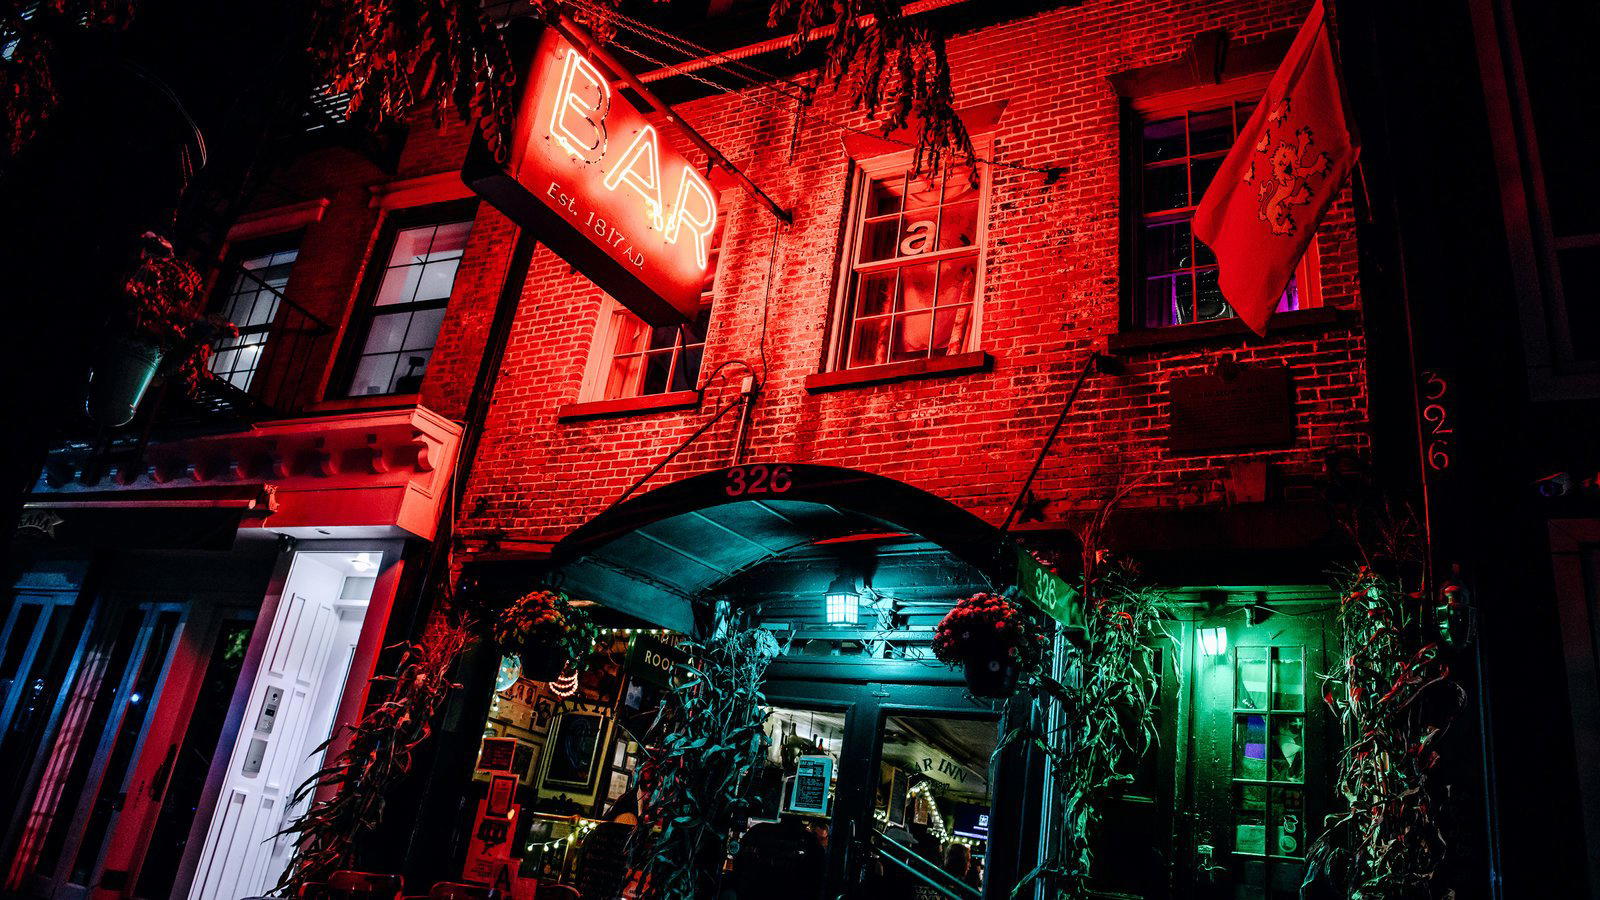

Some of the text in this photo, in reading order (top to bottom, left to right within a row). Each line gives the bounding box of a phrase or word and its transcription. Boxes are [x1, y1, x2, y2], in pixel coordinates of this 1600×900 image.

[545, 181, 579, 217] Est.
[584, 209, 625, 248] 1817
[900, 219, 937, 256] a
[1420, 370, 1453, 471] 326
[725, 464, 793, 497] 326
[1035, 567, 1058, 610] 326
[644, 649, 675, 671] ROO
[938, 757, 968, 784] INN
